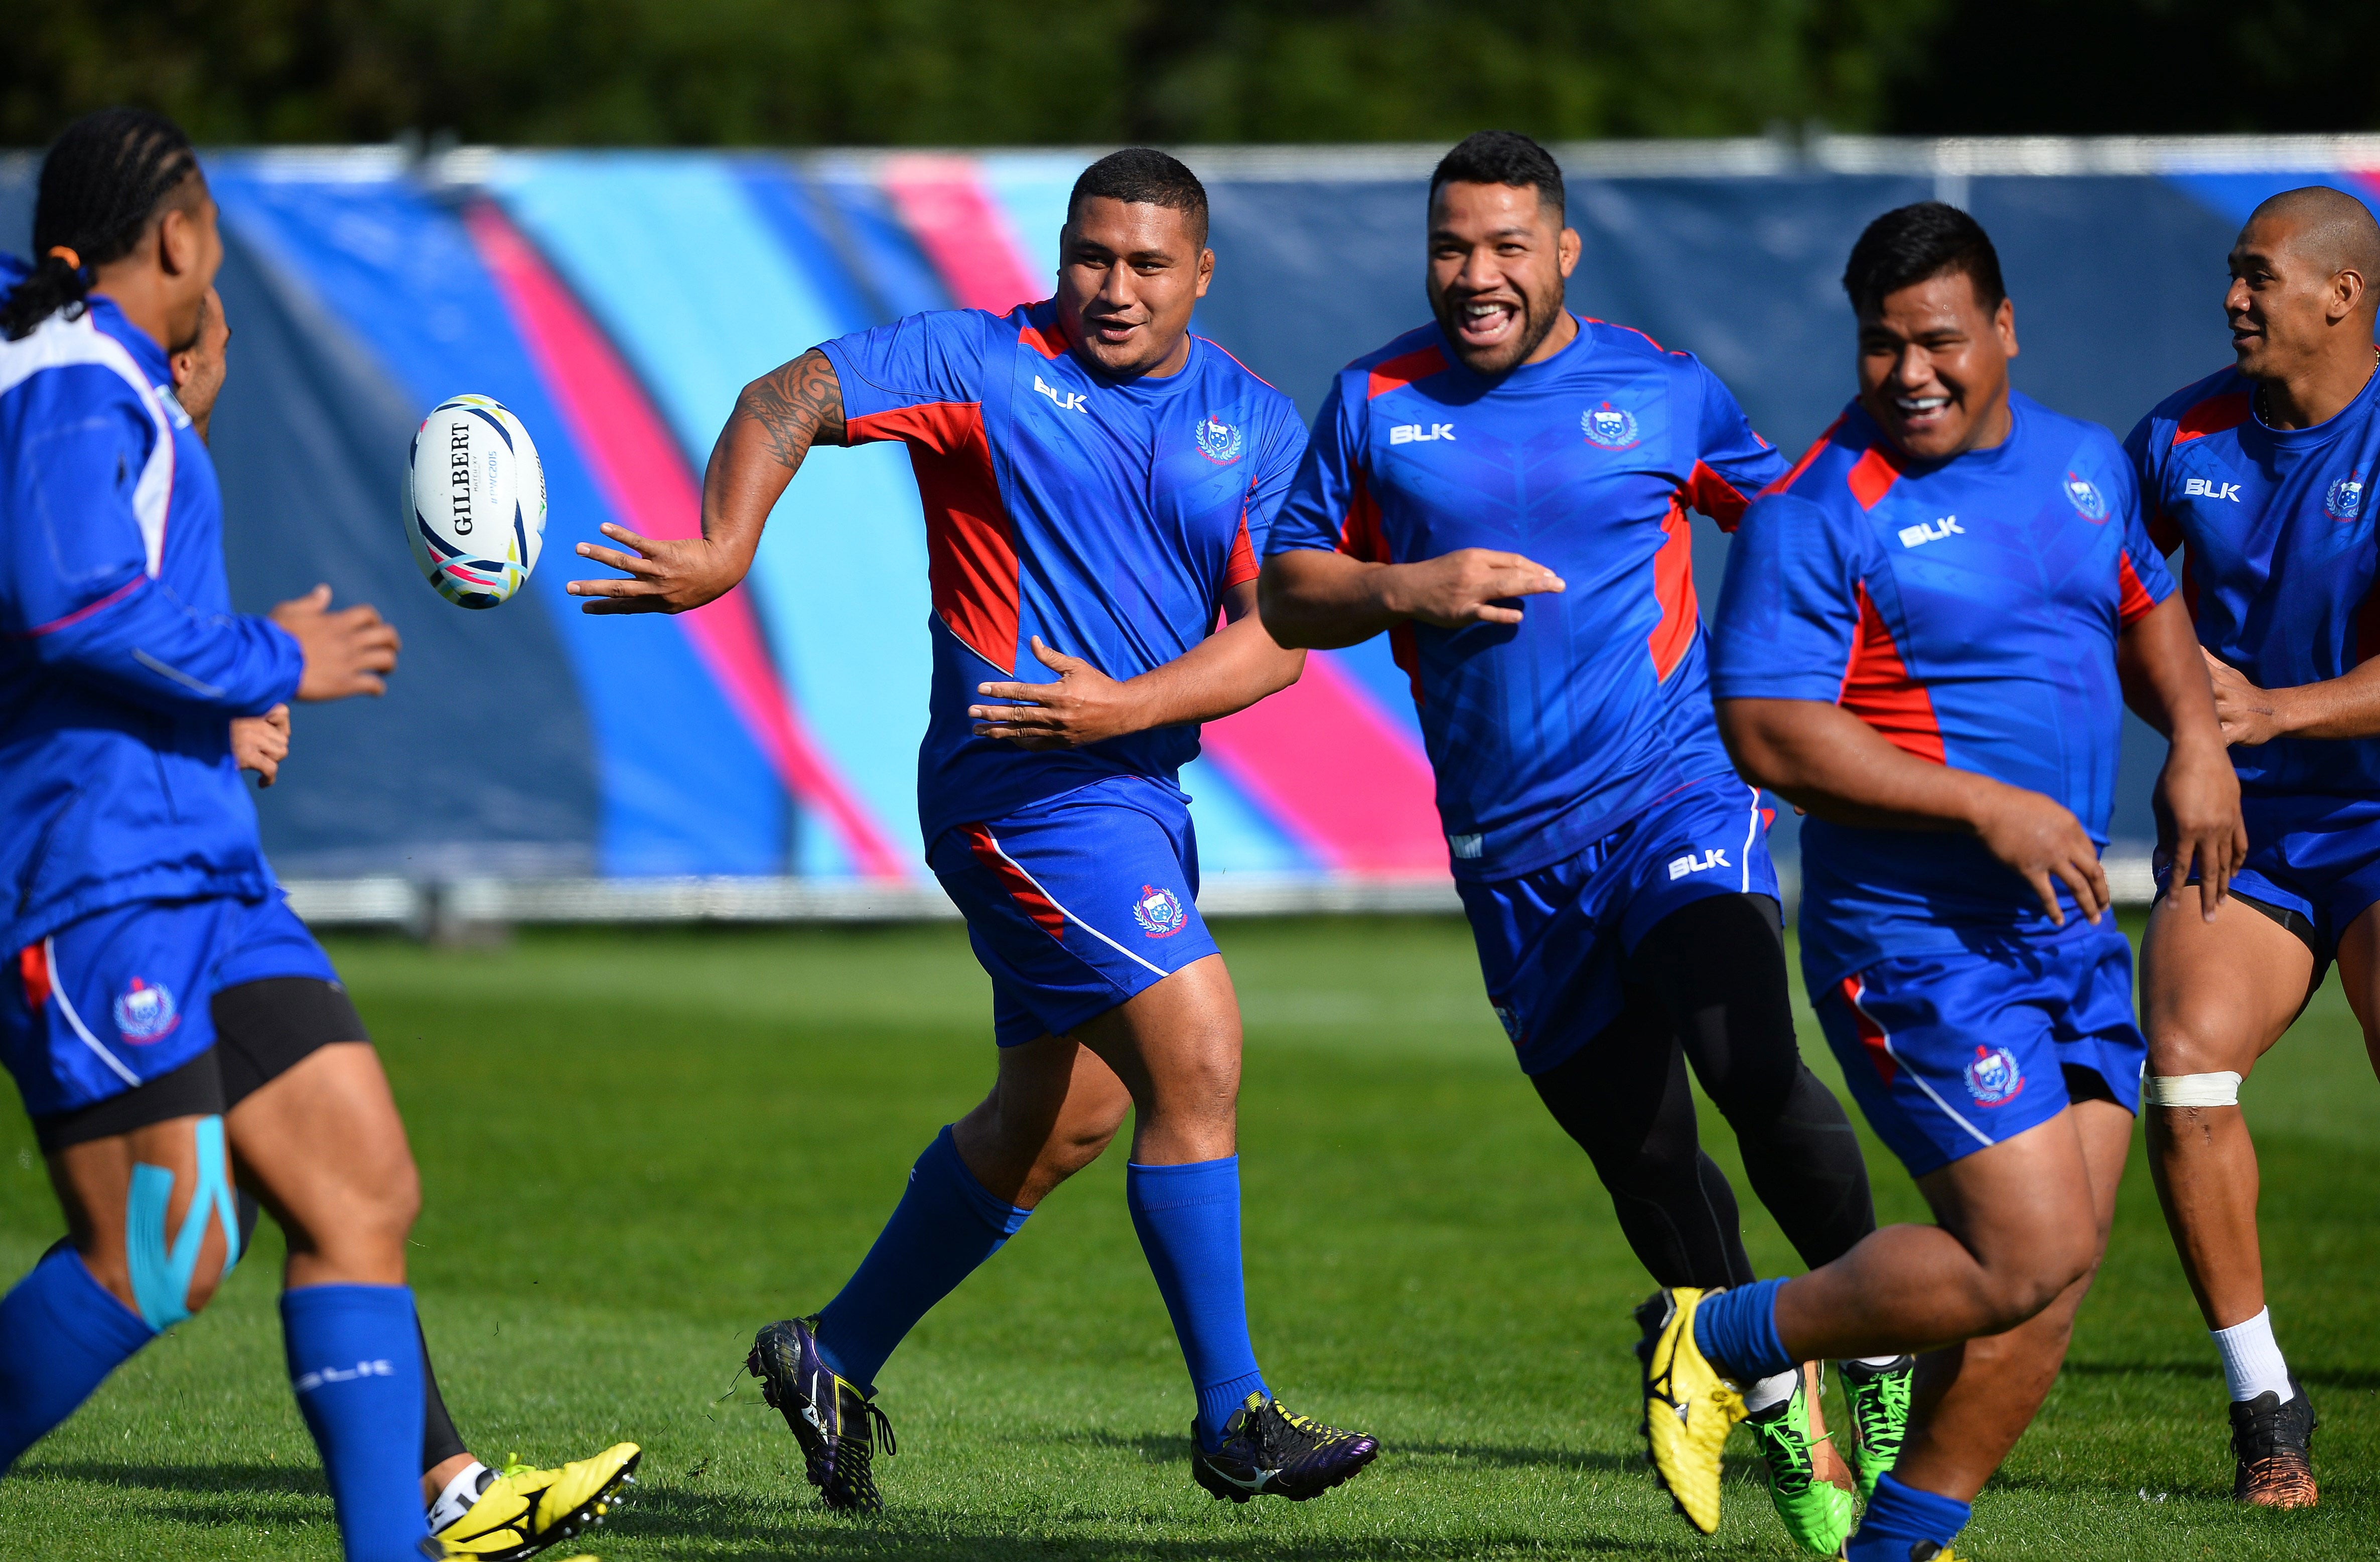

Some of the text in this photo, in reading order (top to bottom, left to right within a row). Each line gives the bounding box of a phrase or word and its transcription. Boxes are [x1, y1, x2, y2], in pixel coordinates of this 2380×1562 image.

[1033, 375, 1088, 414] BLK
[1390, 423, 1456, 445] BLK
[452, 422, 473, 536] GILBERT
[2184, 478, 2242, 502] BLK
[1898, 515, 1966, 548] BLK
[1668, 848, 1731, 881] BLK
